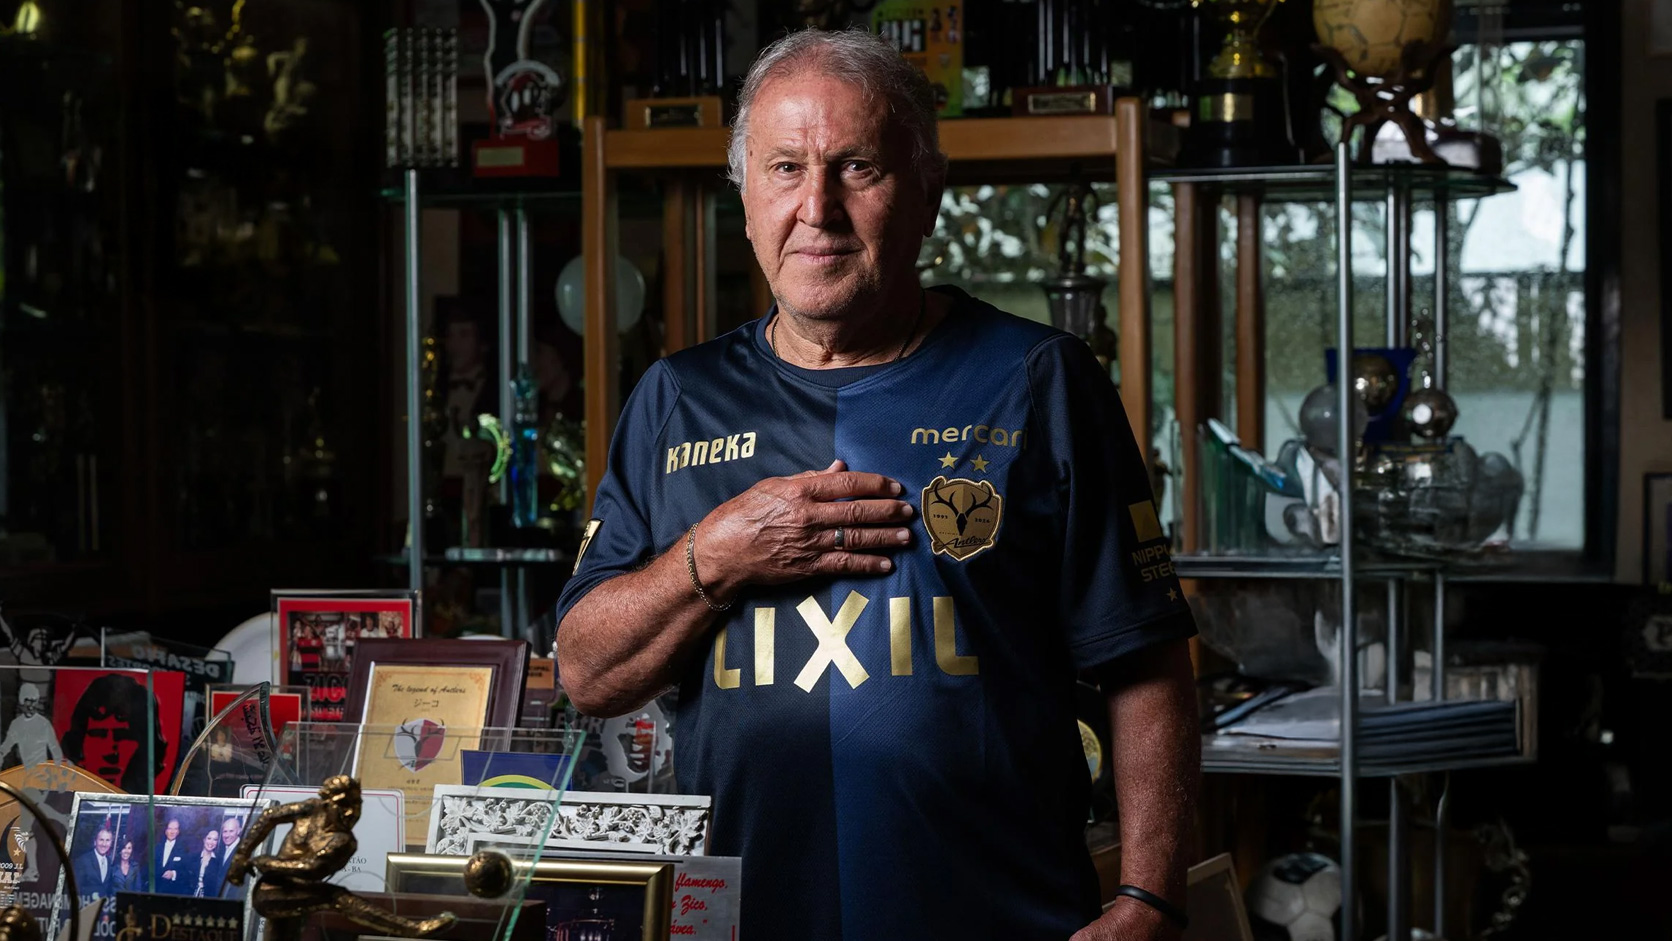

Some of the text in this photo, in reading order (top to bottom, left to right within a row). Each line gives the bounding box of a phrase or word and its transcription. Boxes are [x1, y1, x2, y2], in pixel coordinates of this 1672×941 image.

[910, 425, 1027, 449] mercari
[714, 590, 980, 694] LIXIL
[303, 673, 350, 703] ZIC
[392, 684, 404, 692] The
